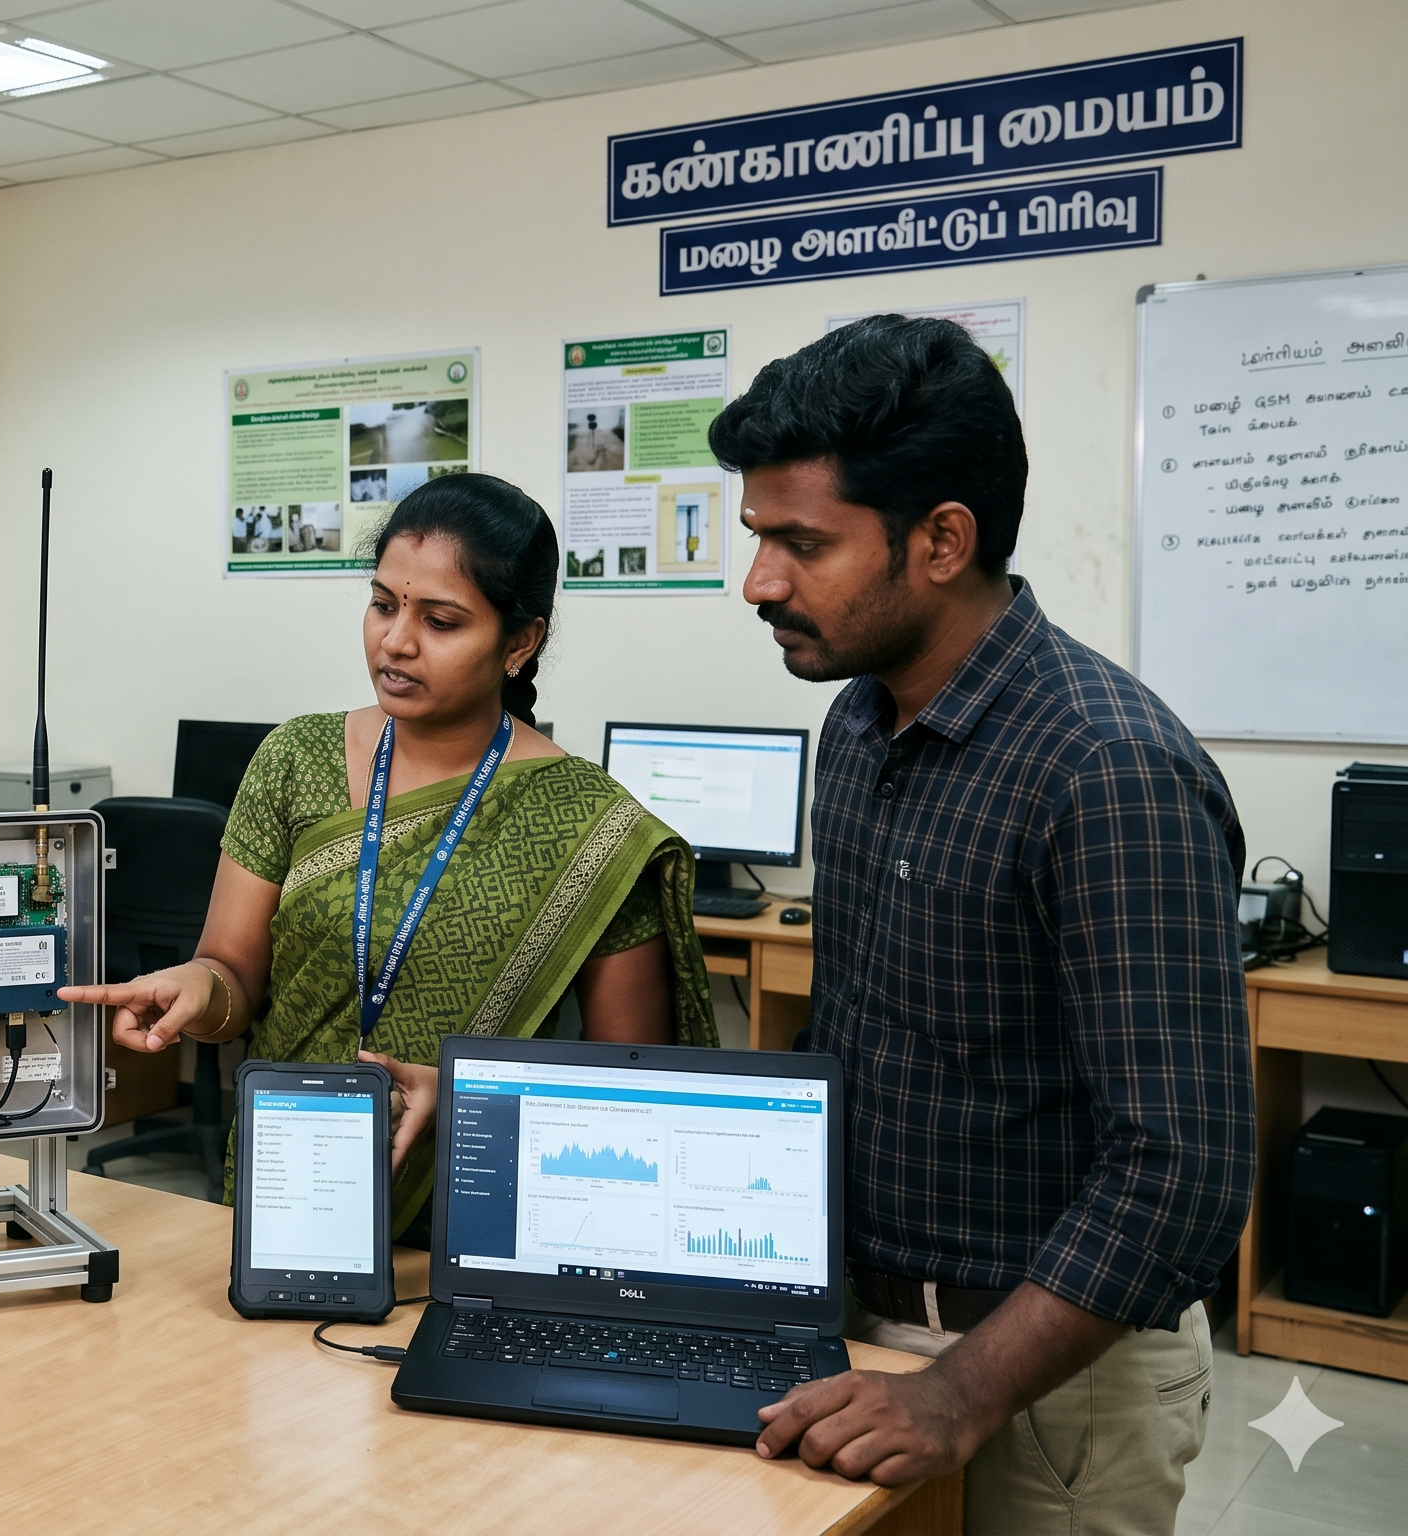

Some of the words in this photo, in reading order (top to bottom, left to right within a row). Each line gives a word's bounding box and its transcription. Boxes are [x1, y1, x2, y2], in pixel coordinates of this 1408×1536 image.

[621, 105, 985, 200] கண்காணிப்பு
[999, 65, 1225, 148] மையம்
[679, 237, 782, 276] மழை
[791, 199, 1007, 262] அளவீட்டுப்
[1018, 190, 1137, 236] பிரிவு
[1254, 393, 1292, 409] GSM
[619, 1288, 646, 1299] DELL
